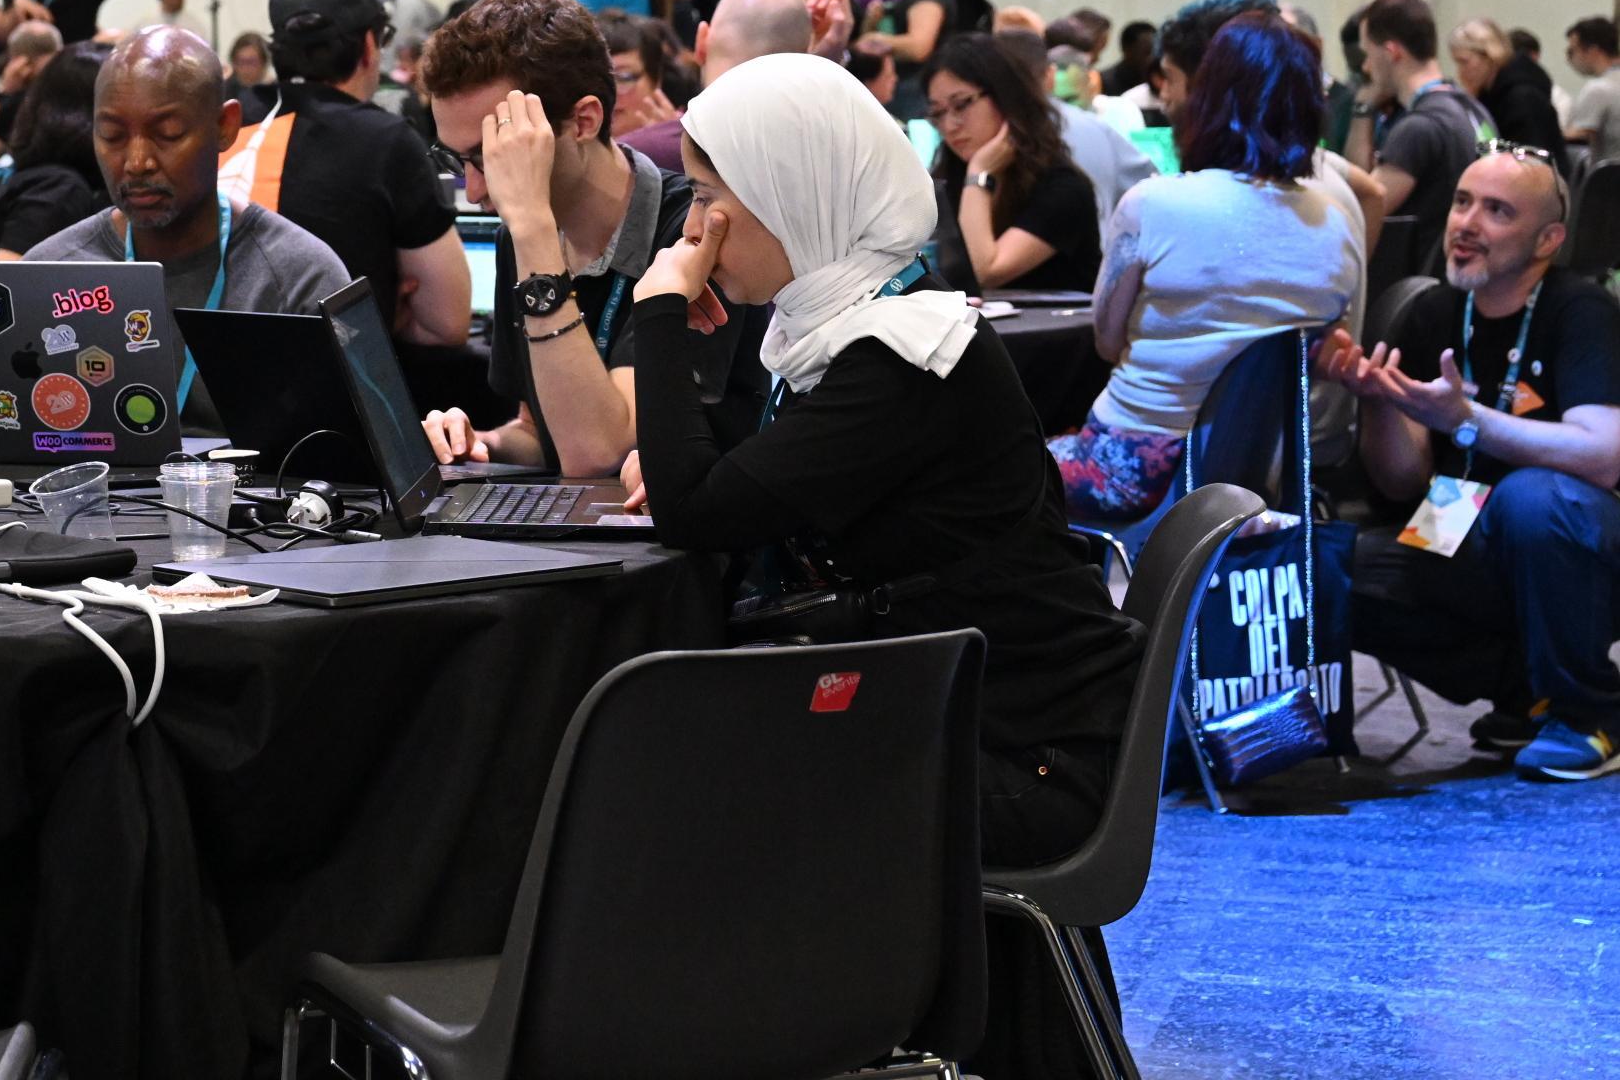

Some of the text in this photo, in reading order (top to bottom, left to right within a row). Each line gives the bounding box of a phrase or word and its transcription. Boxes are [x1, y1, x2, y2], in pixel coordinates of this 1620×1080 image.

[52, 286, 113, 317] .blog
[604, 308, 614, 331] CODE
[1229, 563, 1306, 627] COLPA
[1248, 617, 1294, 677] DEL
